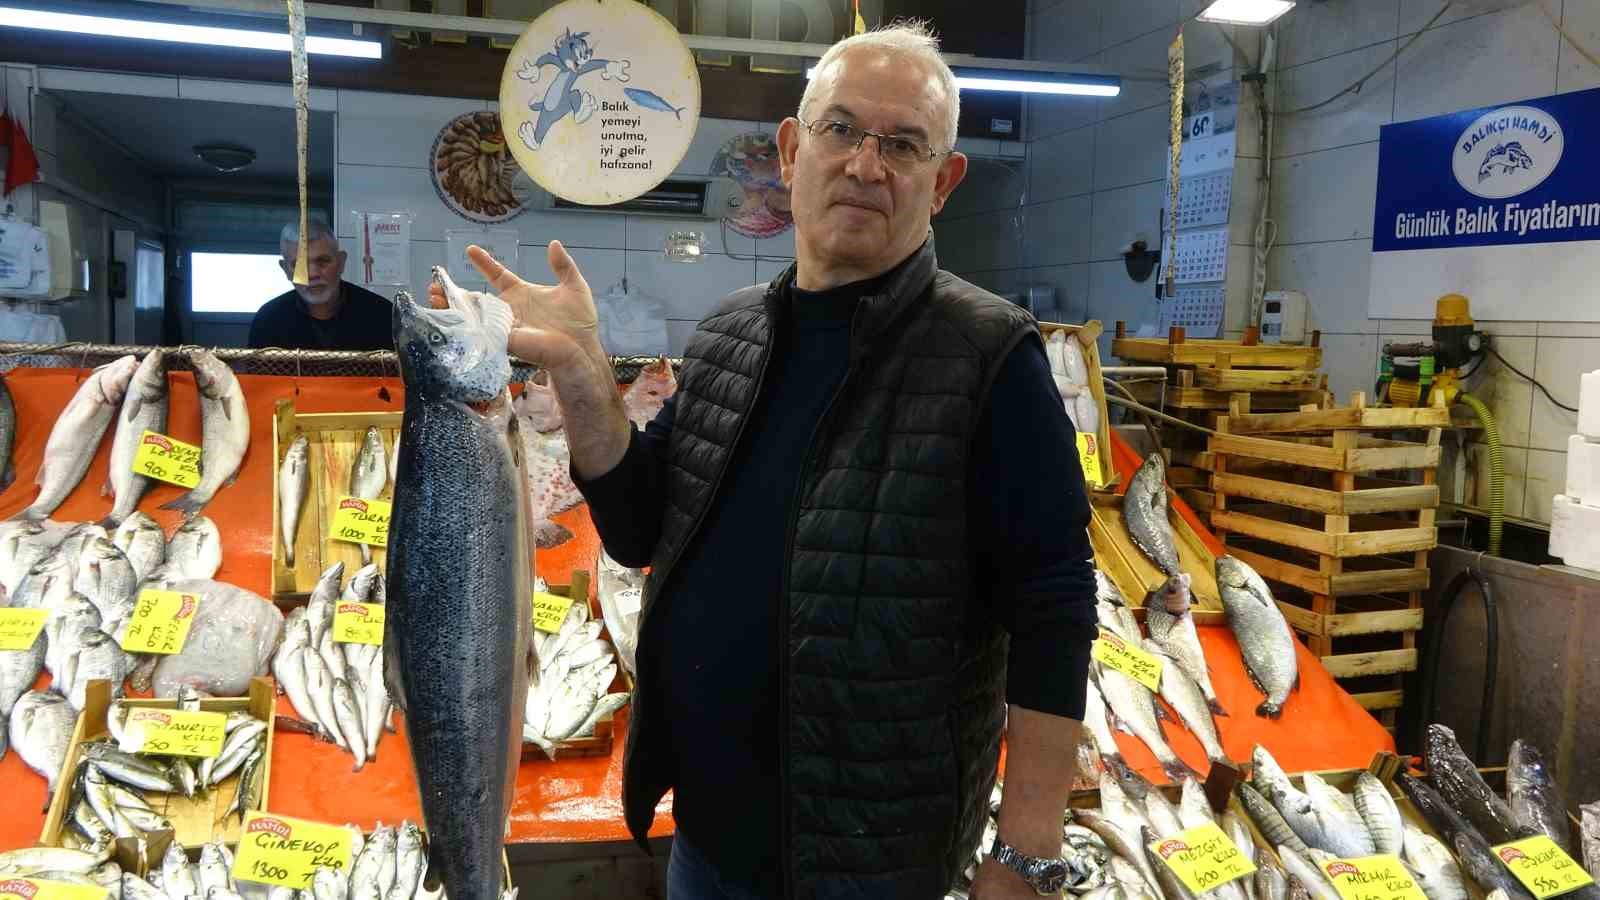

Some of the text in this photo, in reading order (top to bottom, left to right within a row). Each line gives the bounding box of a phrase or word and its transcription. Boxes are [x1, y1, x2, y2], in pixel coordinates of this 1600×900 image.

[601, 101, 629, 111] Balık
[601, 115, 641, 128] yemeyi
[601, 131, 647, 142] unutma,
[1462, 115, 1557, 154] BALIKÇI HAMDİ
[600, 144, 646, 158] iyi gelir
[600, 159, 652, 169] hafızana!
[1395, 209, 1450, 239] Günlük
[1455, 205, 1501, 235] Balık
[144, 461, 167, 478] 900
[340, 526, 365, 540] 1000
[138, 597, 159, 618] 700
[252, 859, 317, 883] 1300 T
[1194, 863, 1241, 889] 600 TL
[1534, 876, 1559, 893] 550
